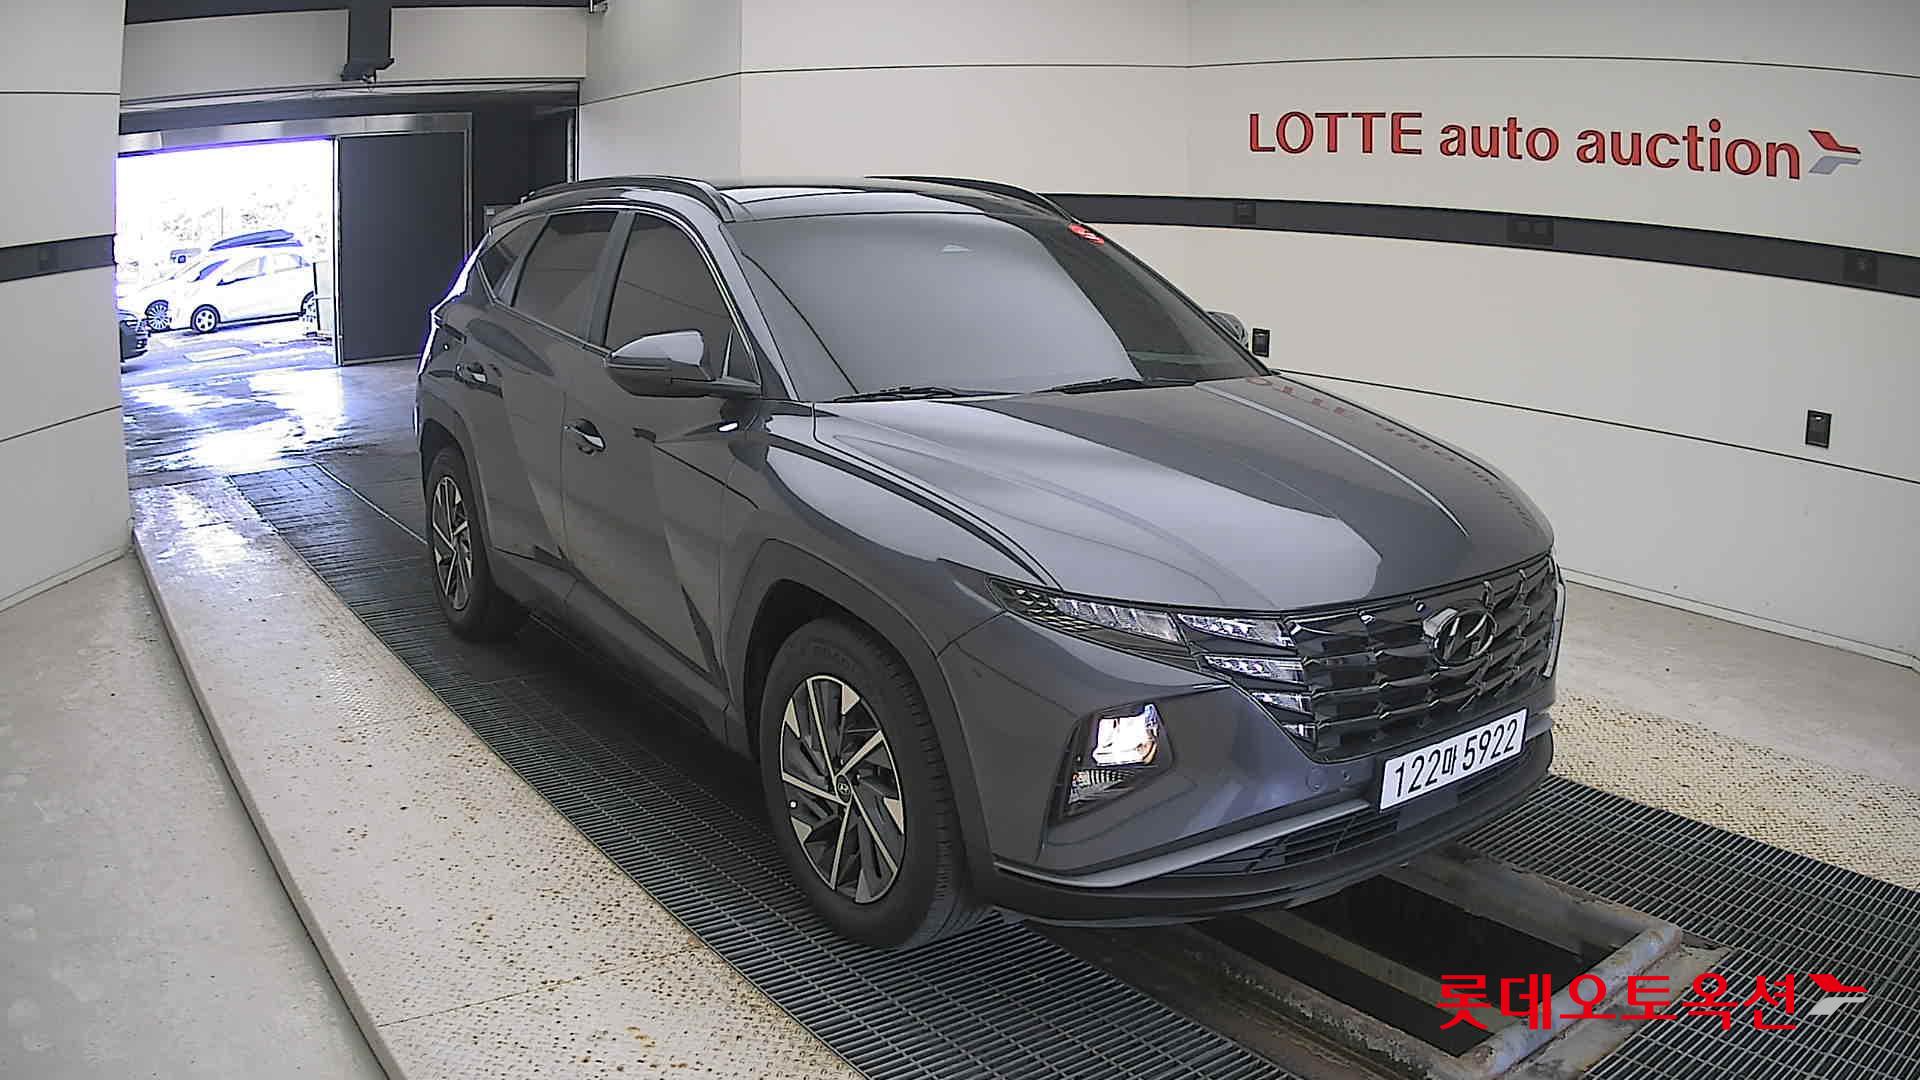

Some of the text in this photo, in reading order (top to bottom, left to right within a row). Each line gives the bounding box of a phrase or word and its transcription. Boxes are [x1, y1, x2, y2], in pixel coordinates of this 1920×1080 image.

[1248, 110, 1801, 180] LOTTE auto auction
[1394, 718, 1518, 798] 122마 5922
